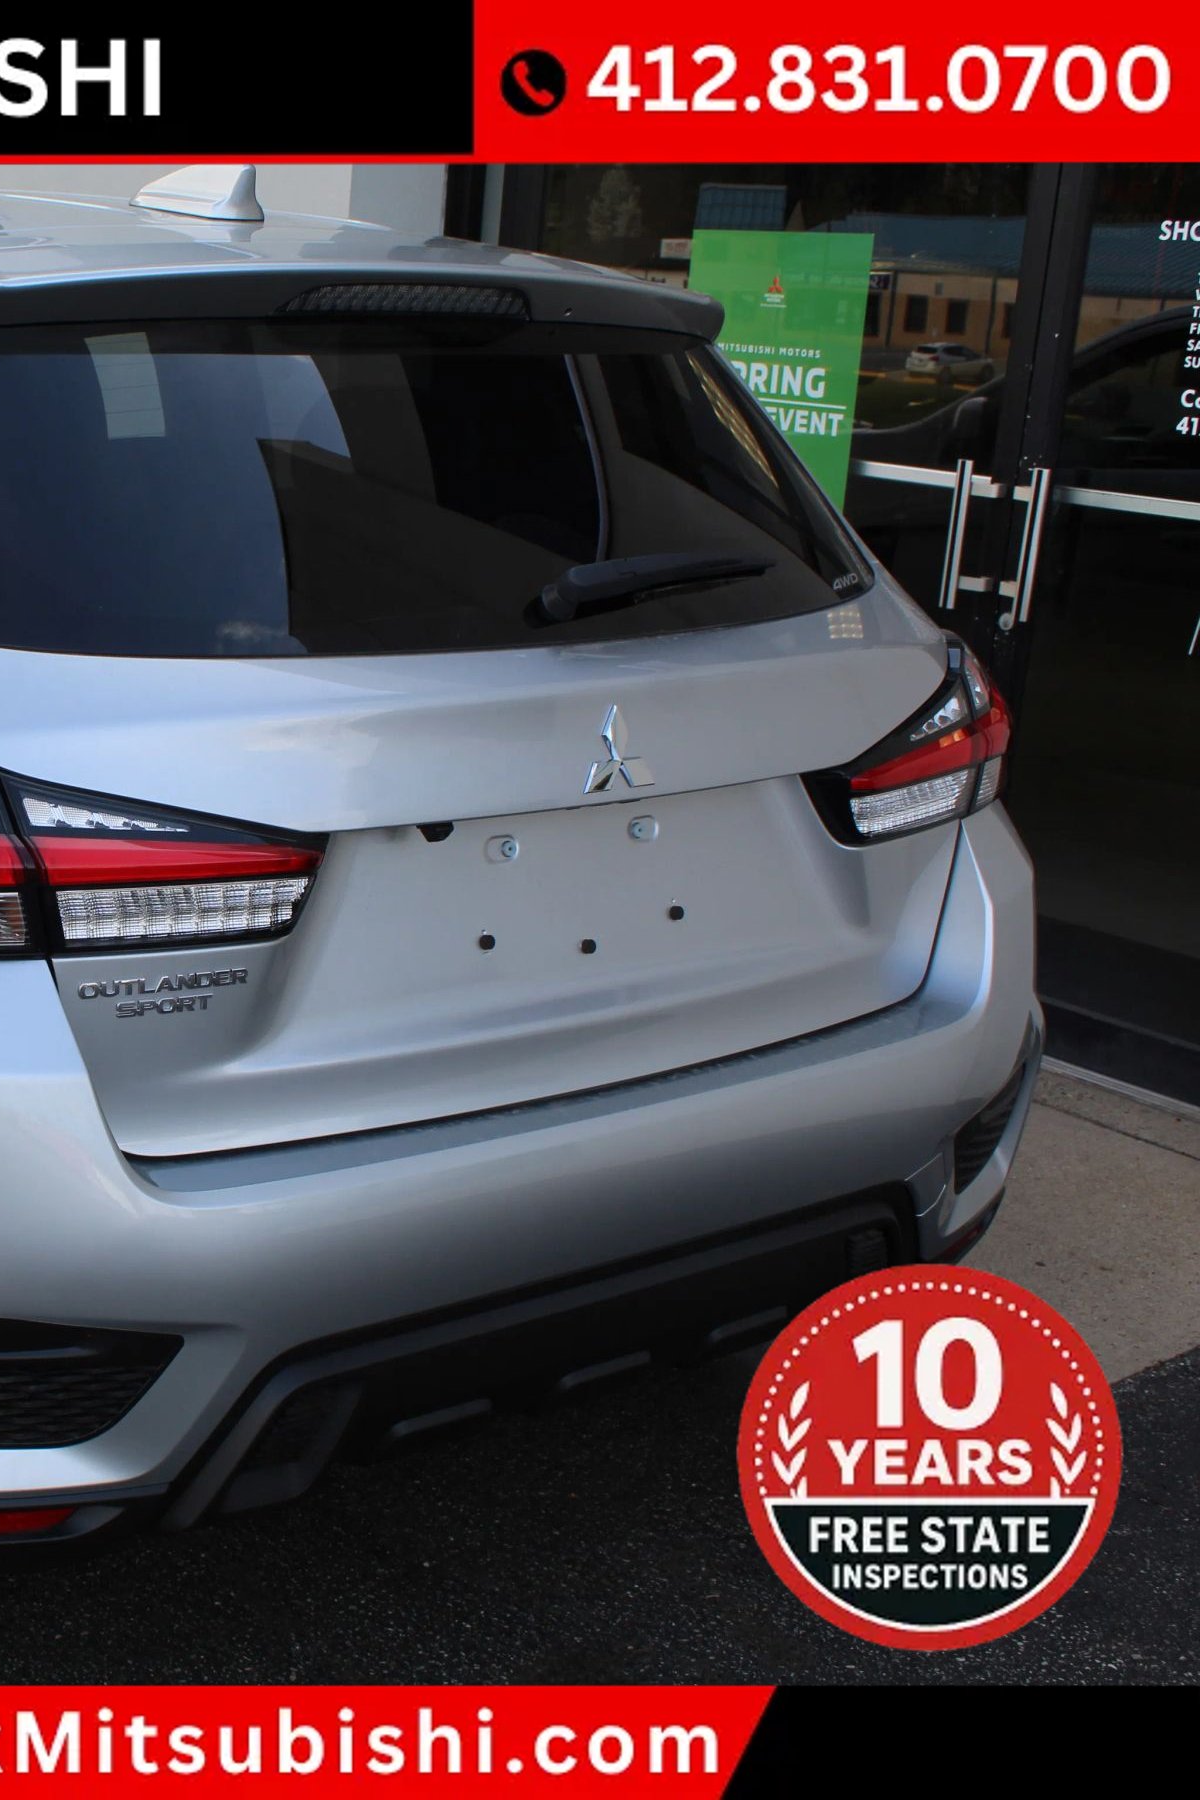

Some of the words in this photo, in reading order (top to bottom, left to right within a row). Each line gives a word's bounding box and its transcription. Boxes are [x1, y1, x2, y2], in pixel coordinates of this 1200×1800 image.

[717, 342, 775, 355] MITSUBISHI
[779, 347, 821, 359] MOTORS
[832, 572, 859, 591] 4WD
[77, 967, 249, 1000] OUTLANDER
[115, 993, 214, 1018] SPORT
